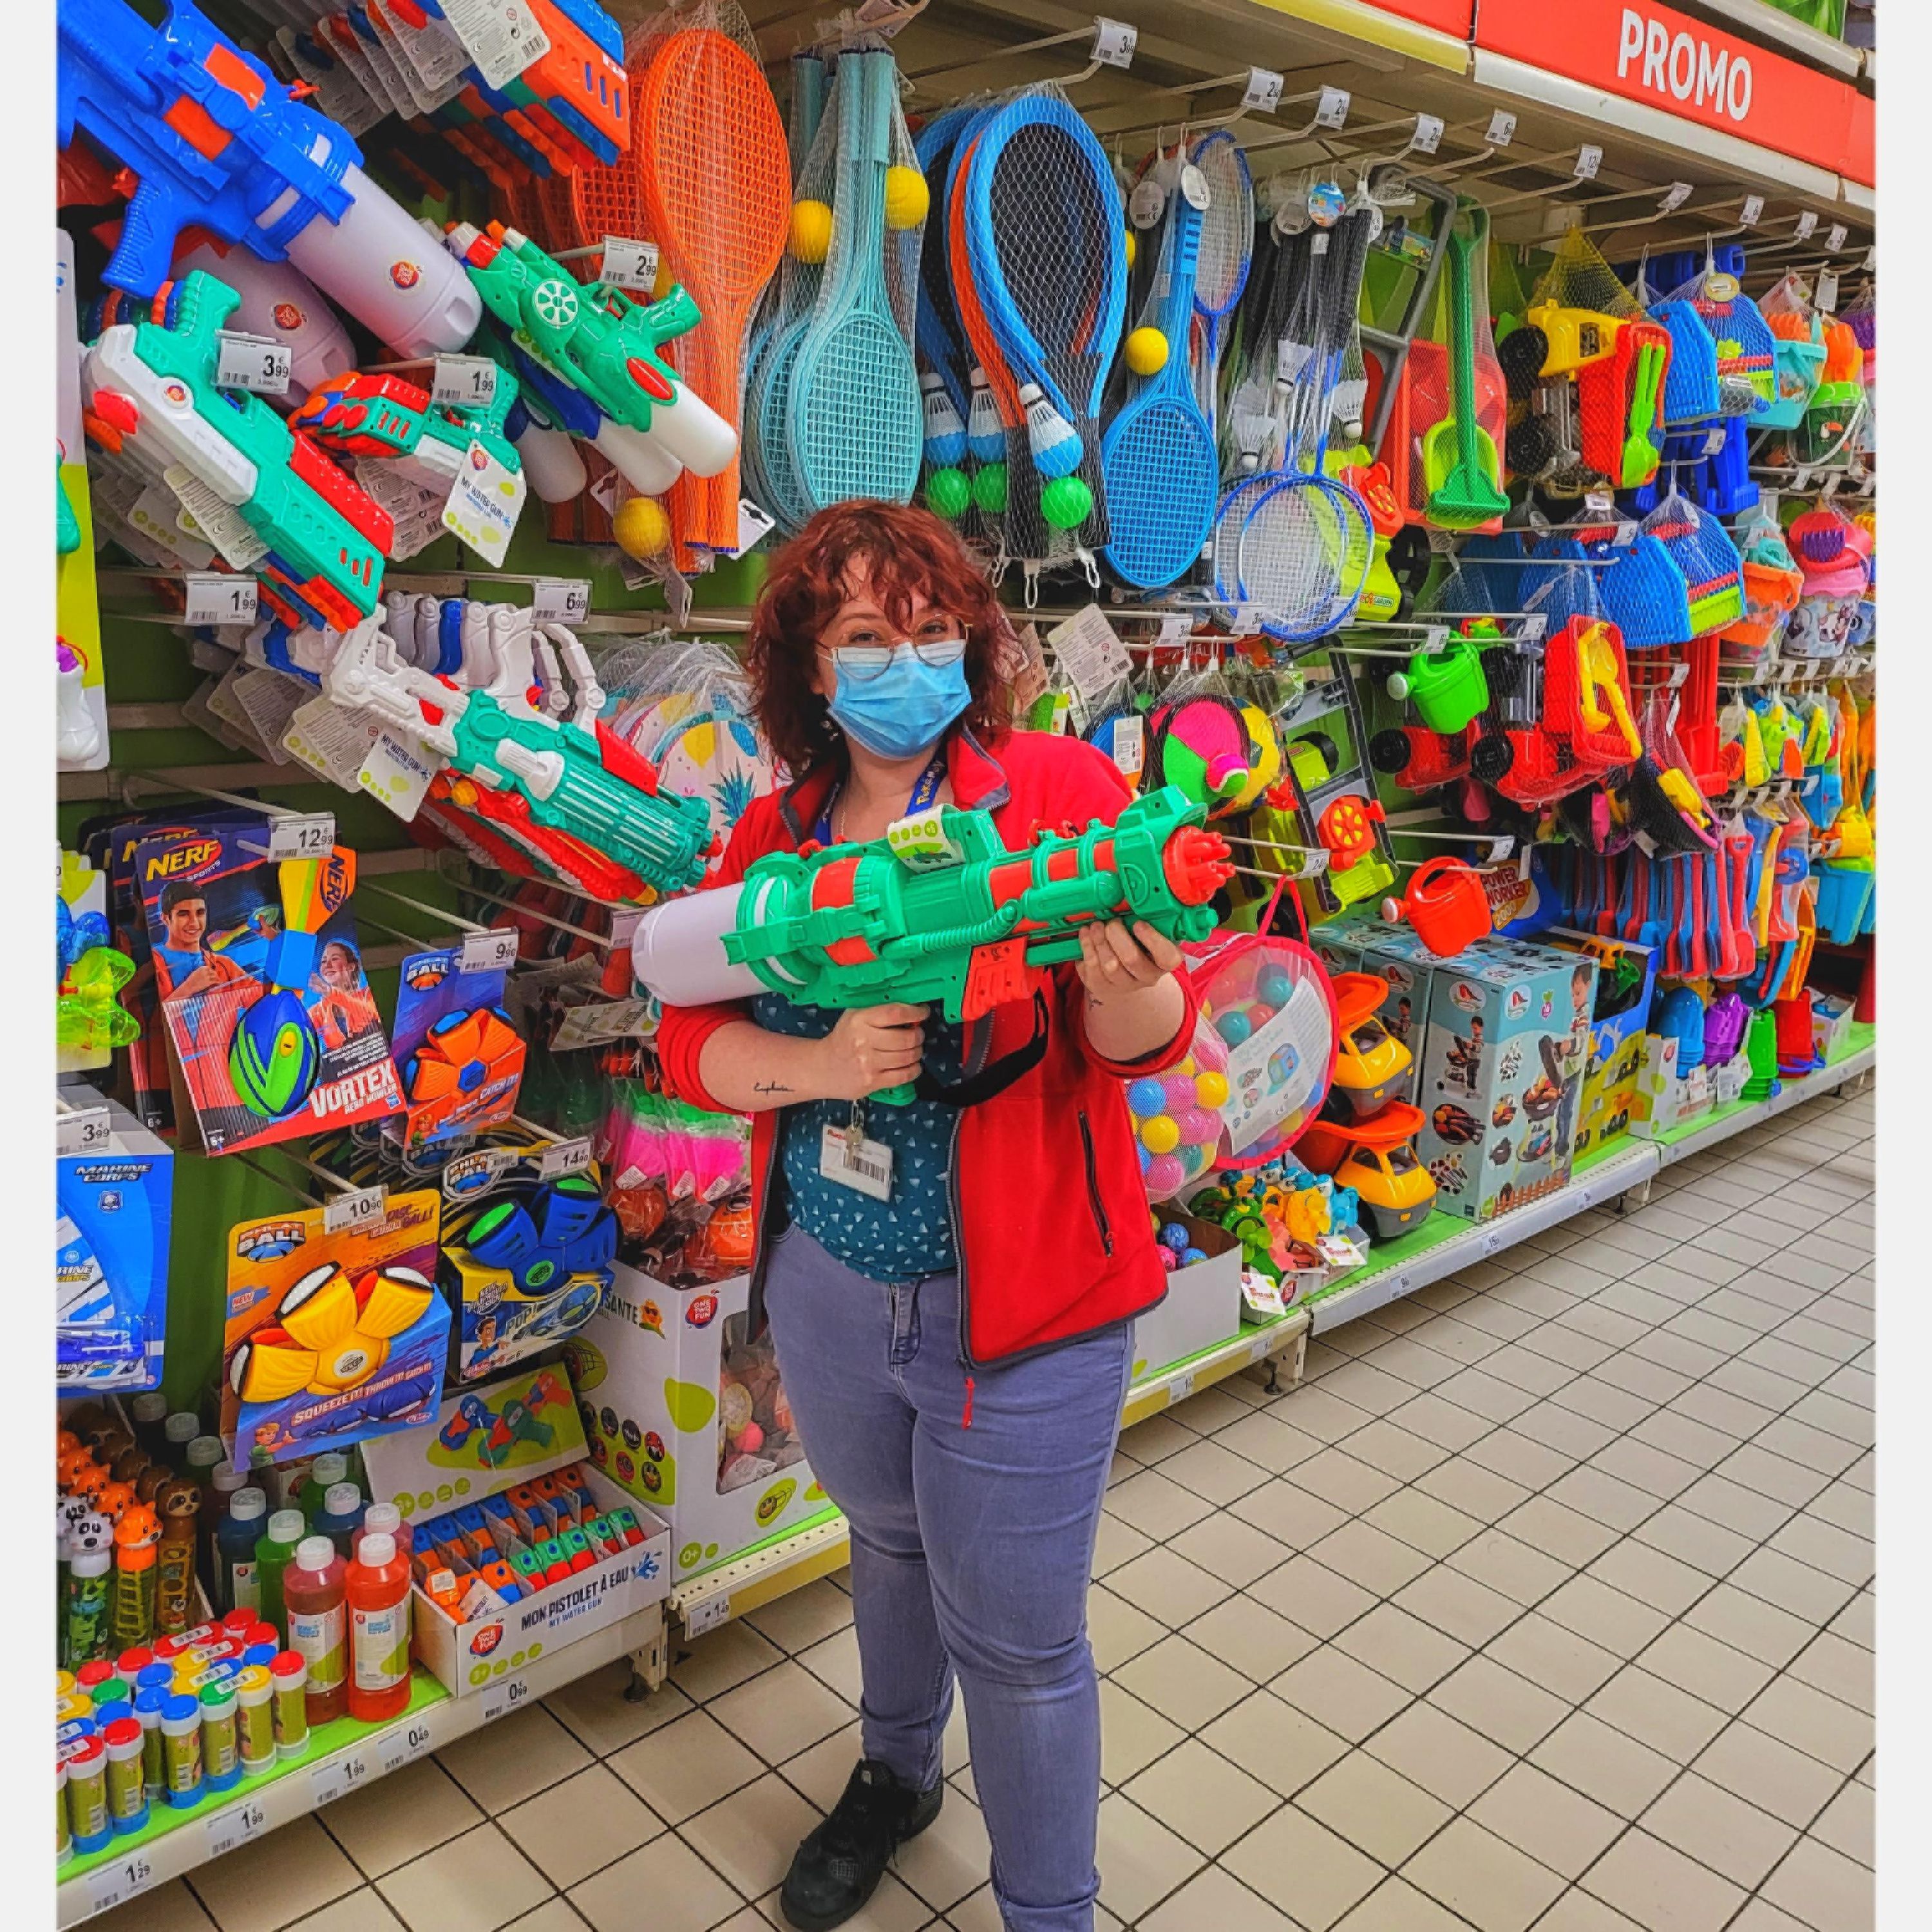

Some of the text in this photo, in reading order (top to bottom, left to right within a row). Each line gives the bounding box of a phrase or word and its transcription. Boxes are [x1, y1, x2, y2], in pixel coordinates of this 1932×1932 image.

[1617, 8, 1752, 121] PROMO
[146, 839, 220, 882] NERF
[185, 859, 222, 882] SPORTS
[406, 963, 450, 982] BALL
[309, 1058, 395, 1118] VORTEX
[75, 1163, 153, 1175] MARINE
[83, 1172, 140, 1183] CORPS
[237, 1229, 306, 1256] BALL
[605, 1293, 639, 1325] SANTE
[693, 1298, 712, 1309] ONE
[694, 1306, 712, 1315] TWO
[694, 1312, 712, 1321] FUN
[294, 1394, 350, 1425] SQUEEZE
[365, 1376, 393, 1397] THROW
[405, 1365, 424, 1380] CATCH
[521, 1565, 629, 1632] MON PISTOLET À EAU
[548, 1596, 603, 1629] MY WATER GUN
